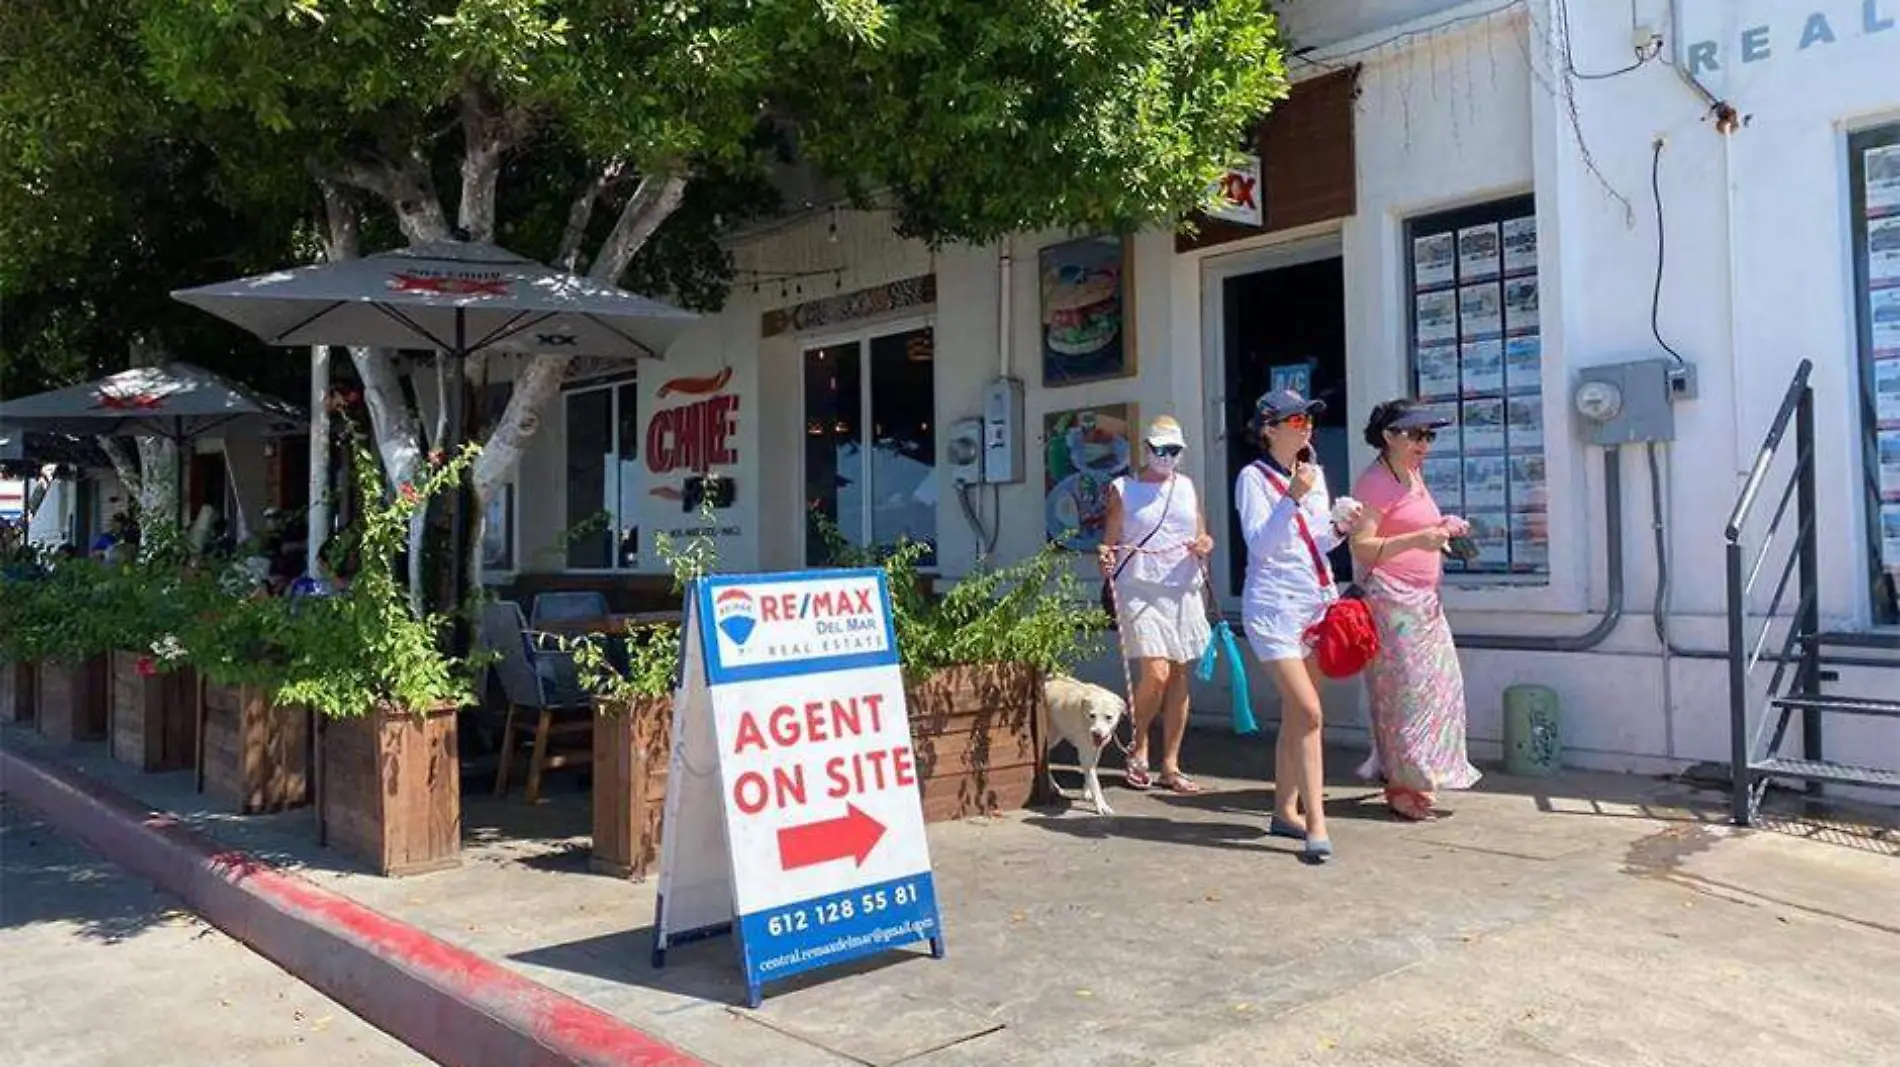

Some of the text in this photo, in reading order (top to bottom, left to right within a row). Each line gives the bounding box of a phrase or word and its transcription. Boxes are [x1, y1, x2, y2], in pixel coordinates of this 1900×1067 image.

[1687, 0, 1895, 76] REAL
[760, 587, 874, 623] RE/MAX
[768, 642, 811, 656] REAL
[822, 635, 883, 652] ESTATE
[734, 693, 884, 755] AGENT
[733, 746, 915, 815] ON SITE
[767, 883, 918, 937] 612 128 55 81
